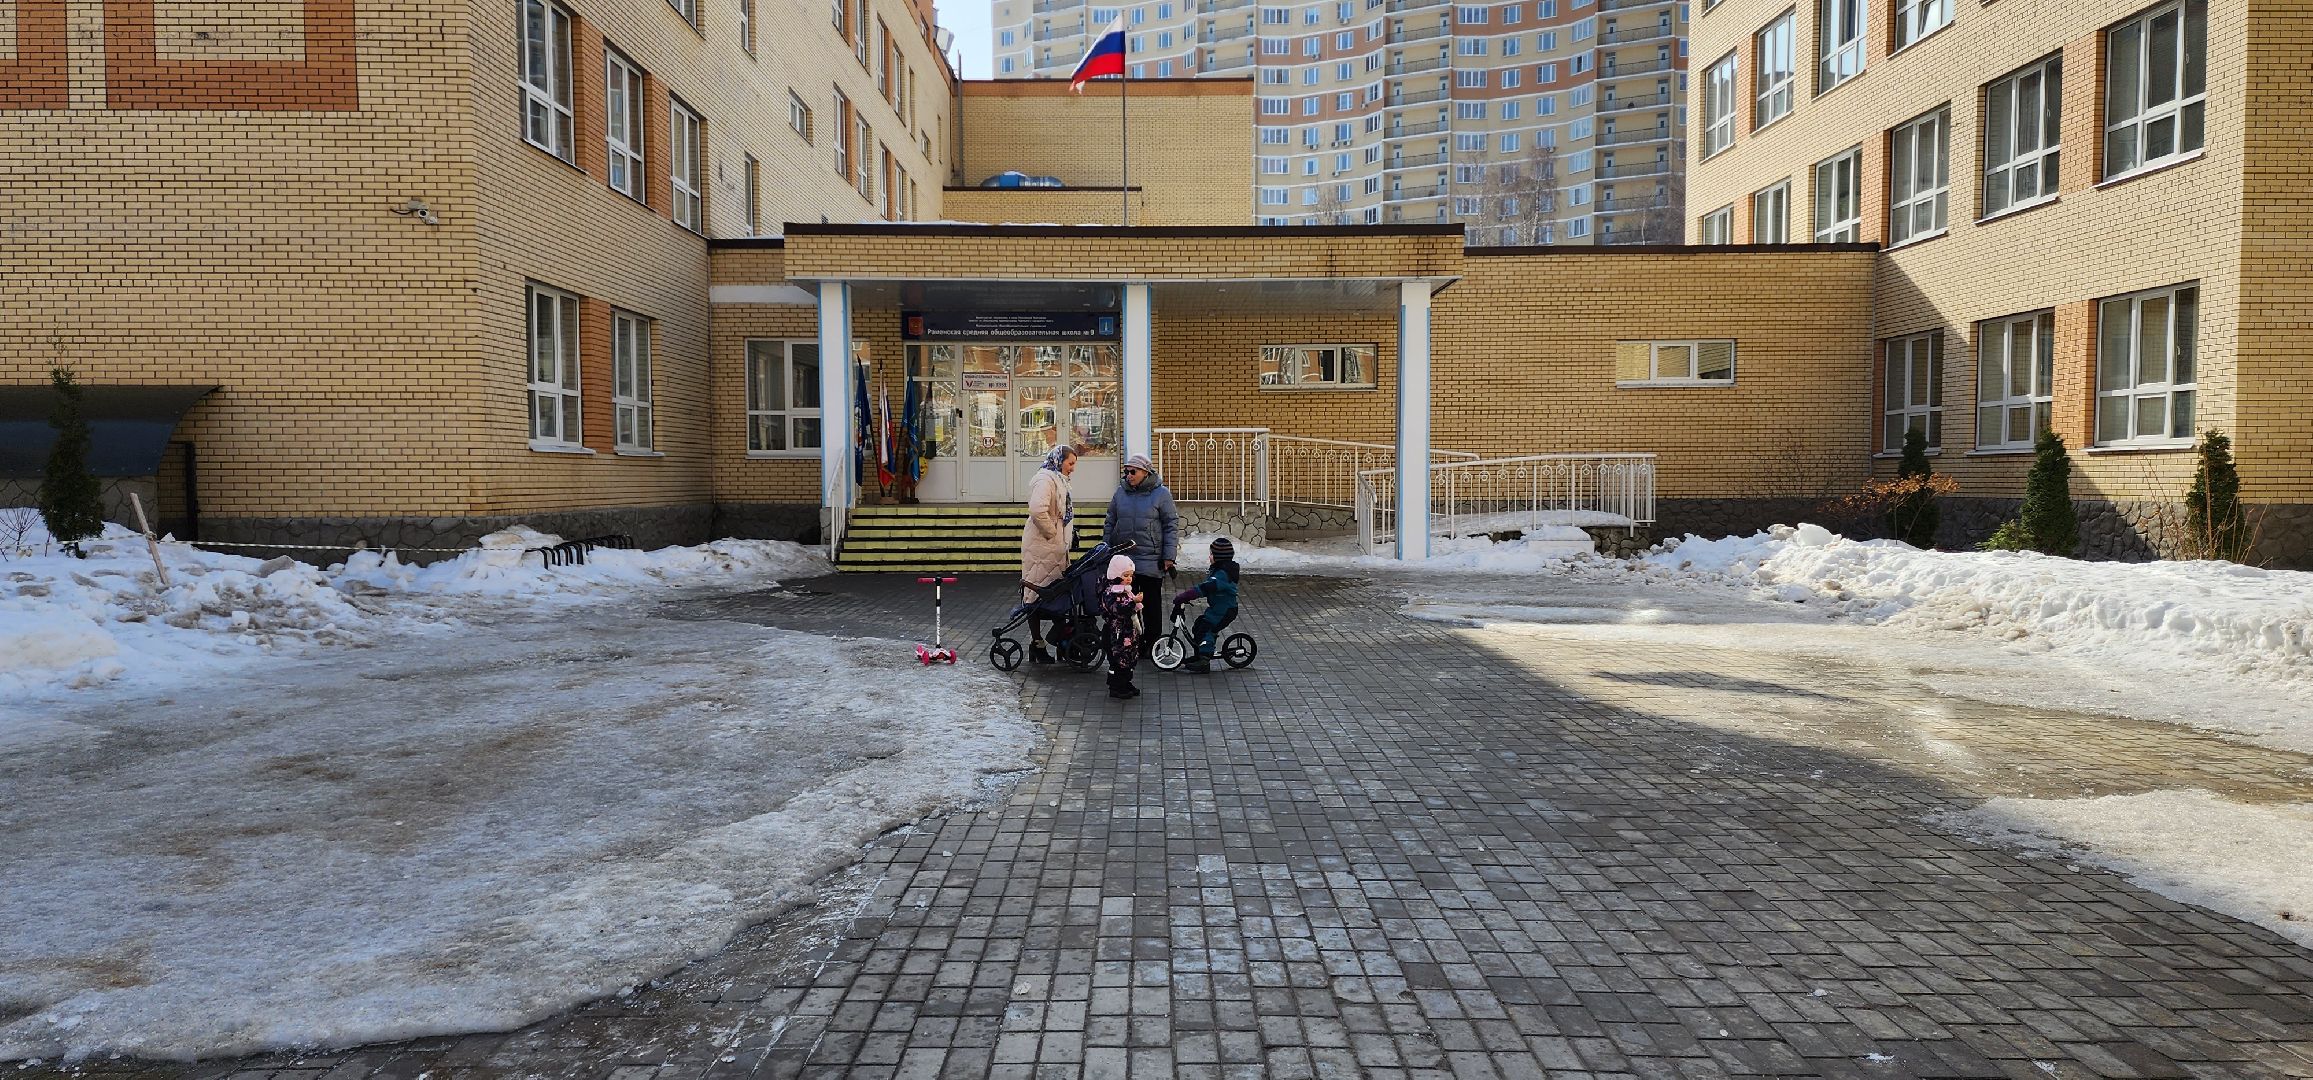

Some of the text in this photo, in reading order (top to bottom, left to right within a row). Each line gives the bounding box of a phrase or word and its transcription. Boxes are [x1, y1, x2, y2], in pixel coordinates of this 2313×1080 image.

[927, 328, 961, 336] Раменская
[962, 329, 989, 337] средняя
[990, 328, 1060, 337] общеобразовательная
